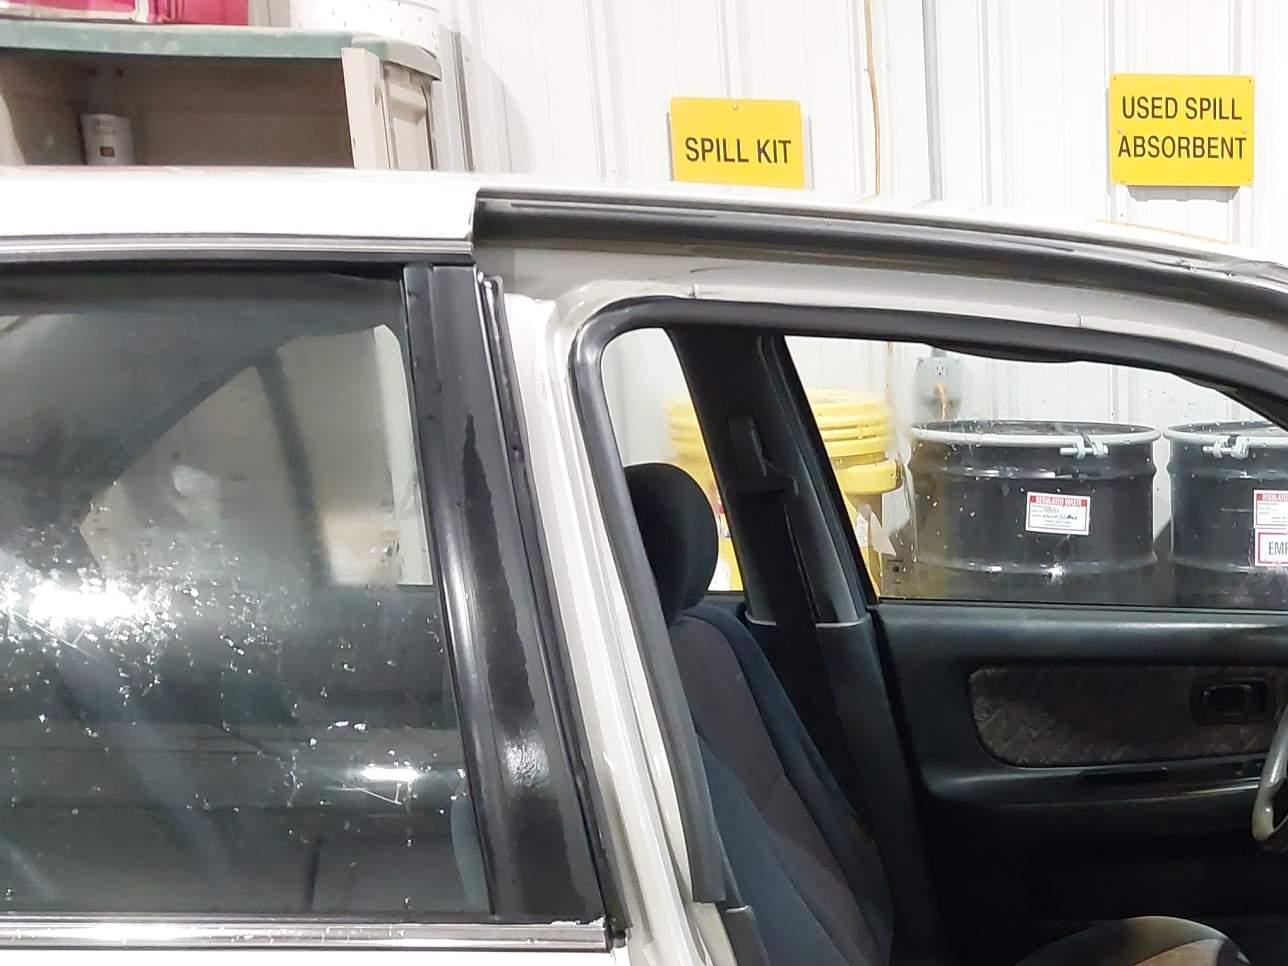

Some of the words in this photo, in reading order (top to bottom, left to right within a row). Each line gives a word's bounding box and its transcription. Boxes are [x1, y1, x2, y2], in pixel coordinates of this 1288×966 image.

[1122, 96, 1178, 119] USED
[1185, 97, 1242, 120] SPILL
[685, 137, 749, 163] SPILL
[756, 139, 792, 164] KIT
[1118, 135, 1247, 160] ABSORBENT
